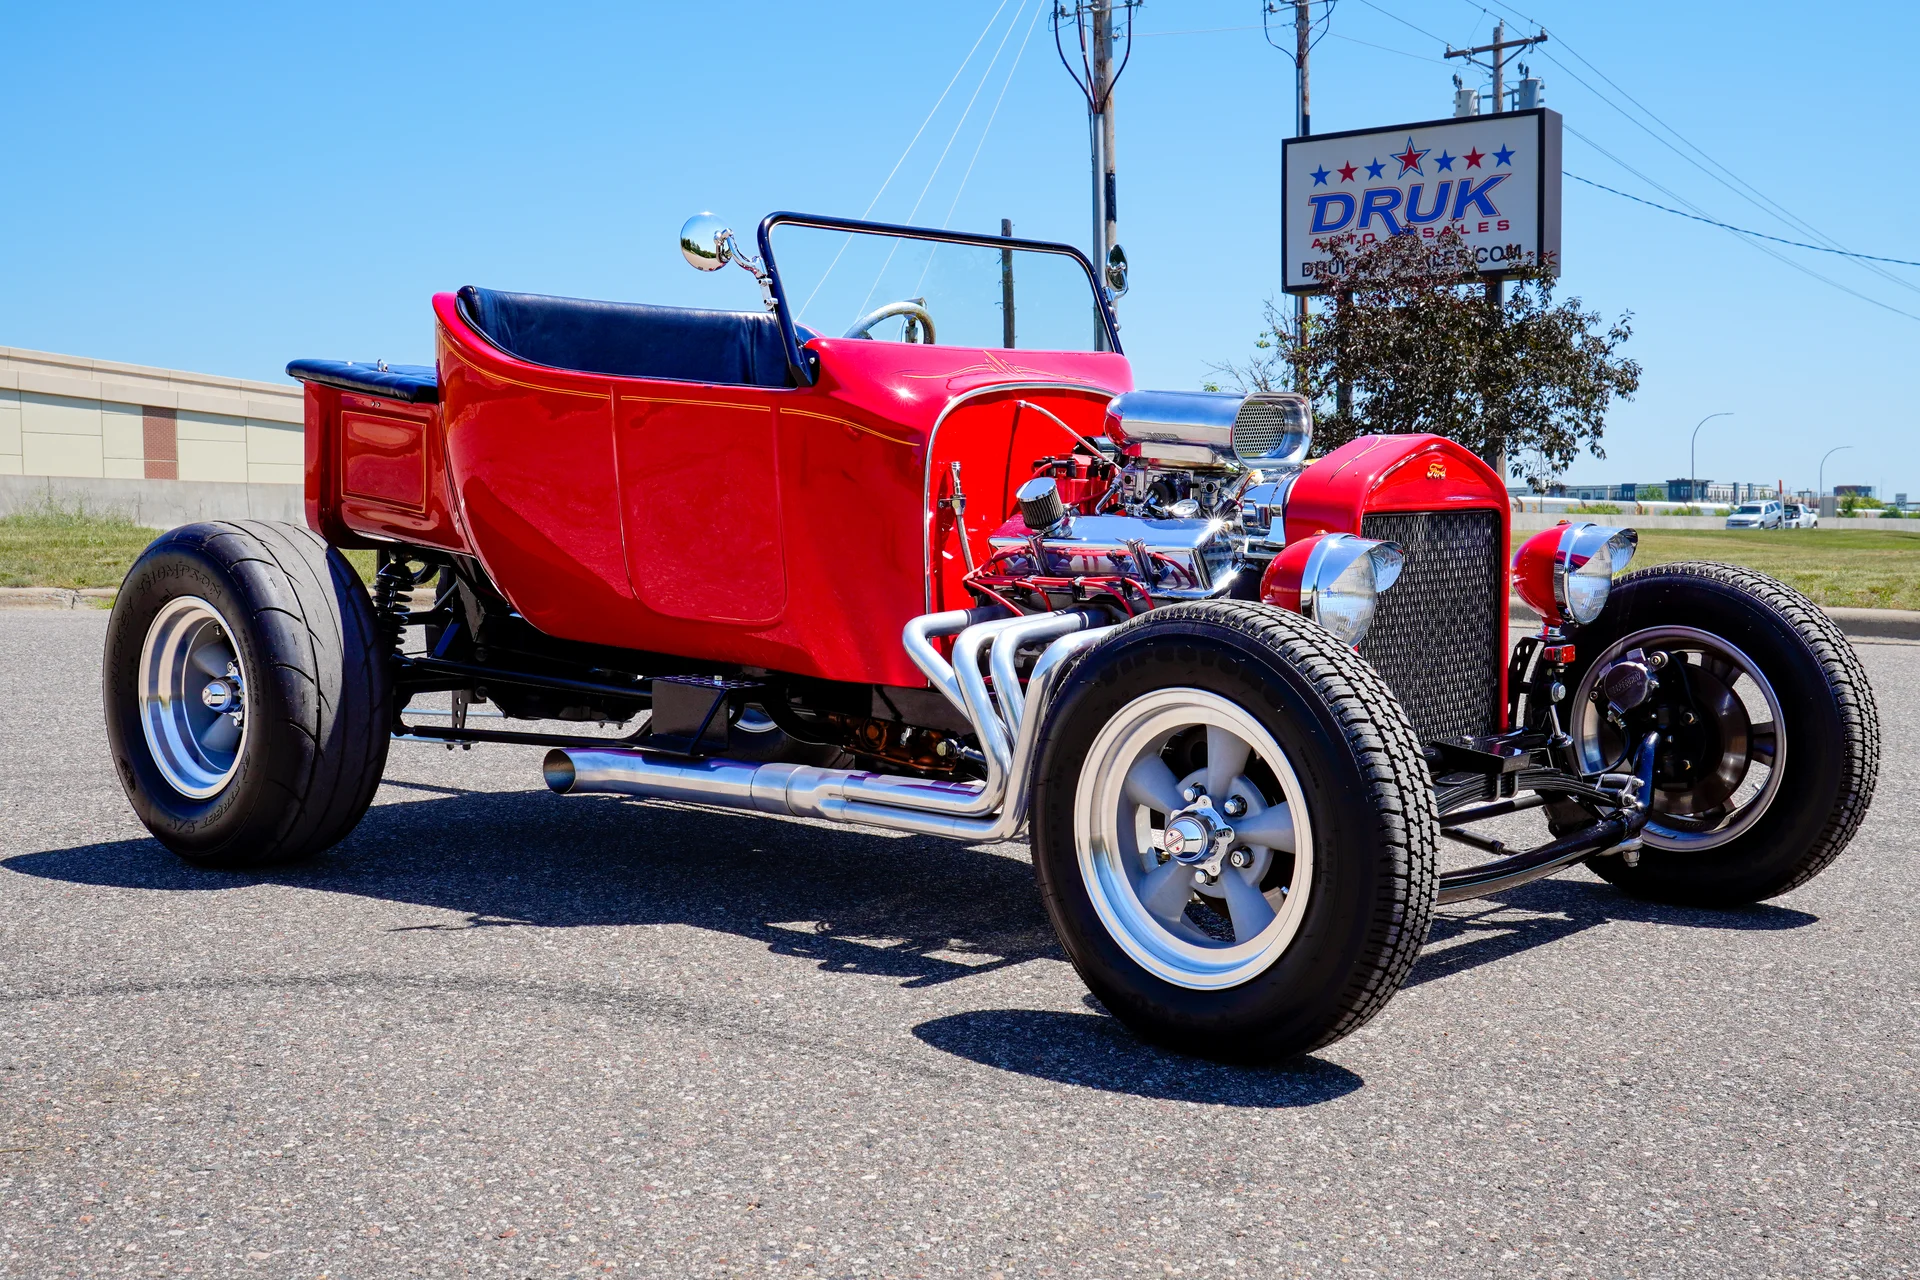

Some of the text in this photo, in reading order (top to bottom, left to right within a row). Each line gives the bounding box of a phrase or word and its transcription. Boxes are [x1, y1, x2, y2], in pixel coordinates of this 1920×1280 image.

[1308, 173, 1512, 236] DRUK
[1422, 220, 1510, 239] SALES
[1426, 463, 1447, 478] Ford
[138, 563, 222, 600] THOMPSON
